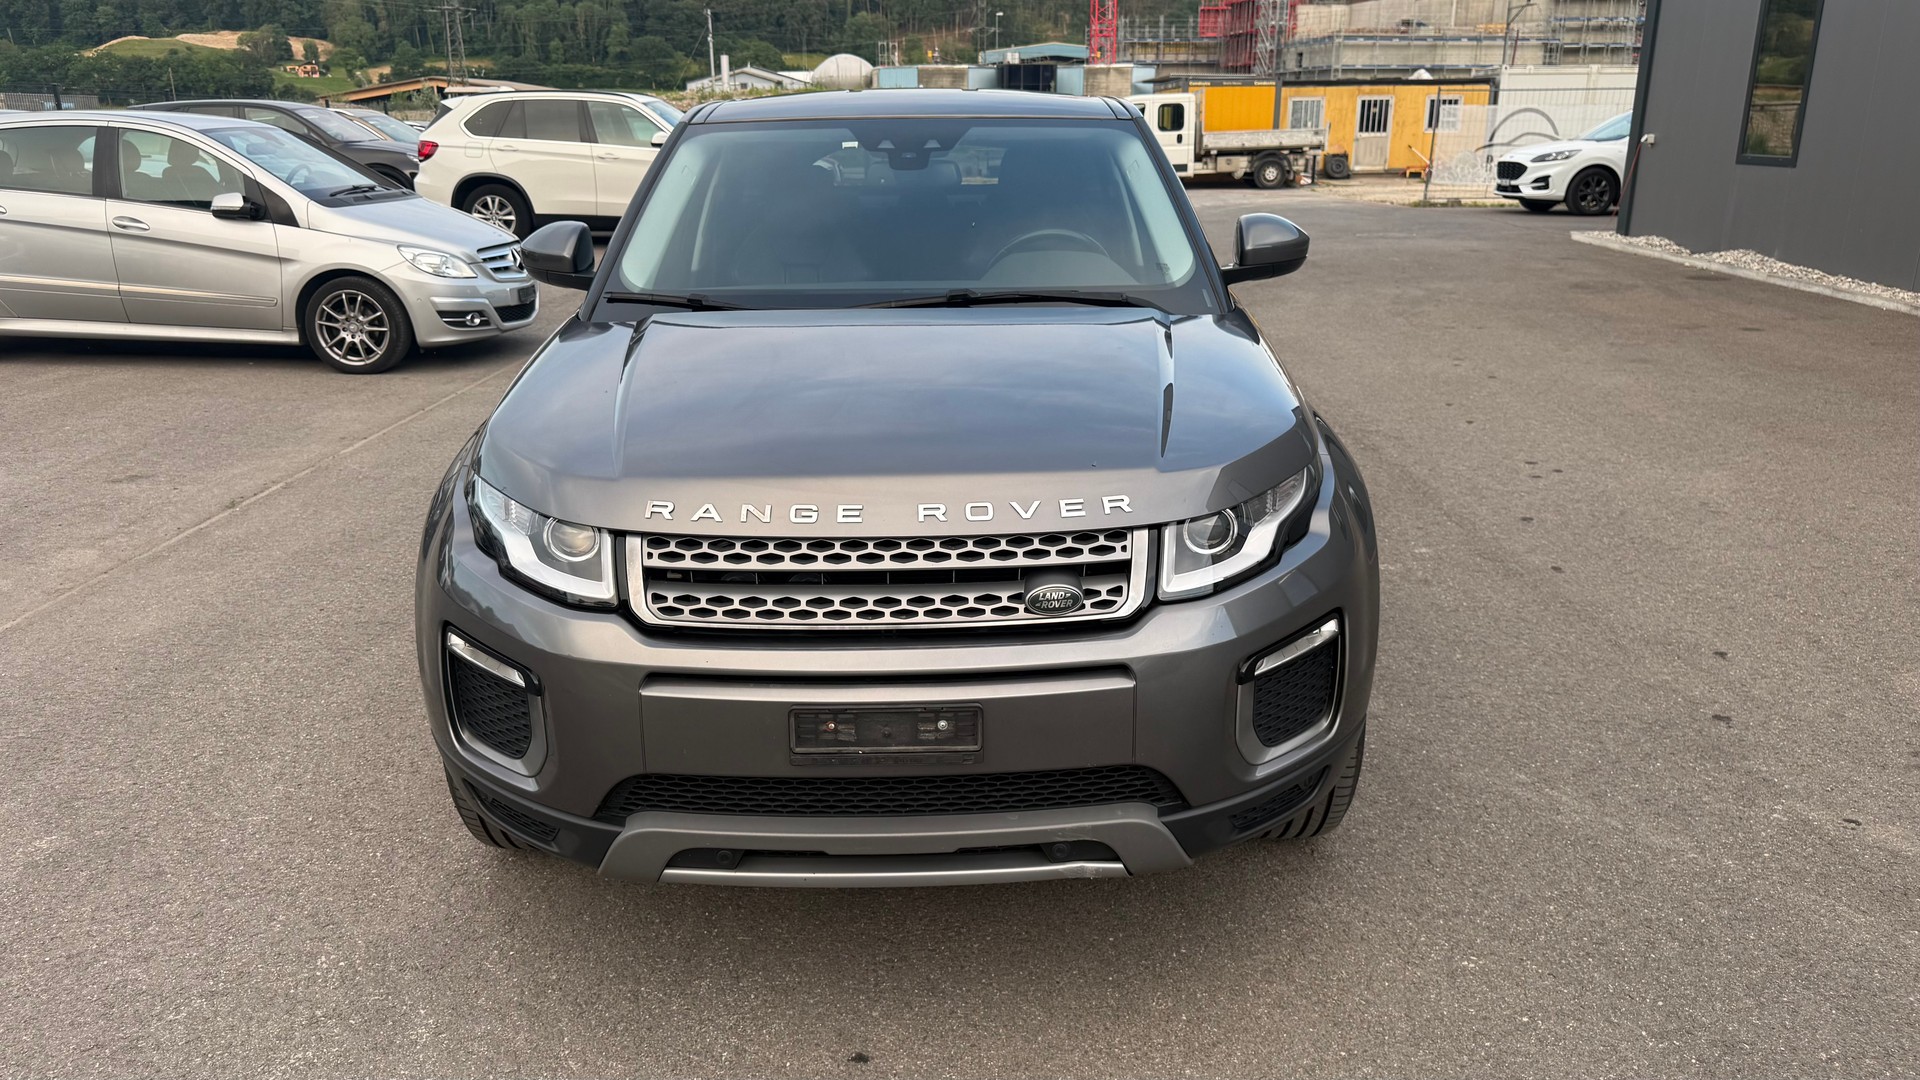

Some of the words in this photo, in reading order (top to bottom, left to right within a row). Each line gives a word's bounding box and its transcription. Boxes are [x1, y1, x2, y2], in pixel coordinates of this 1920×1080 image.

[645, 500, 864, 524] RANGE
[917, 495, 1134, 522] ROVER
[1038, 591, 1065, 601] LAND
[1040, 599, 1073, 609] ROVER
